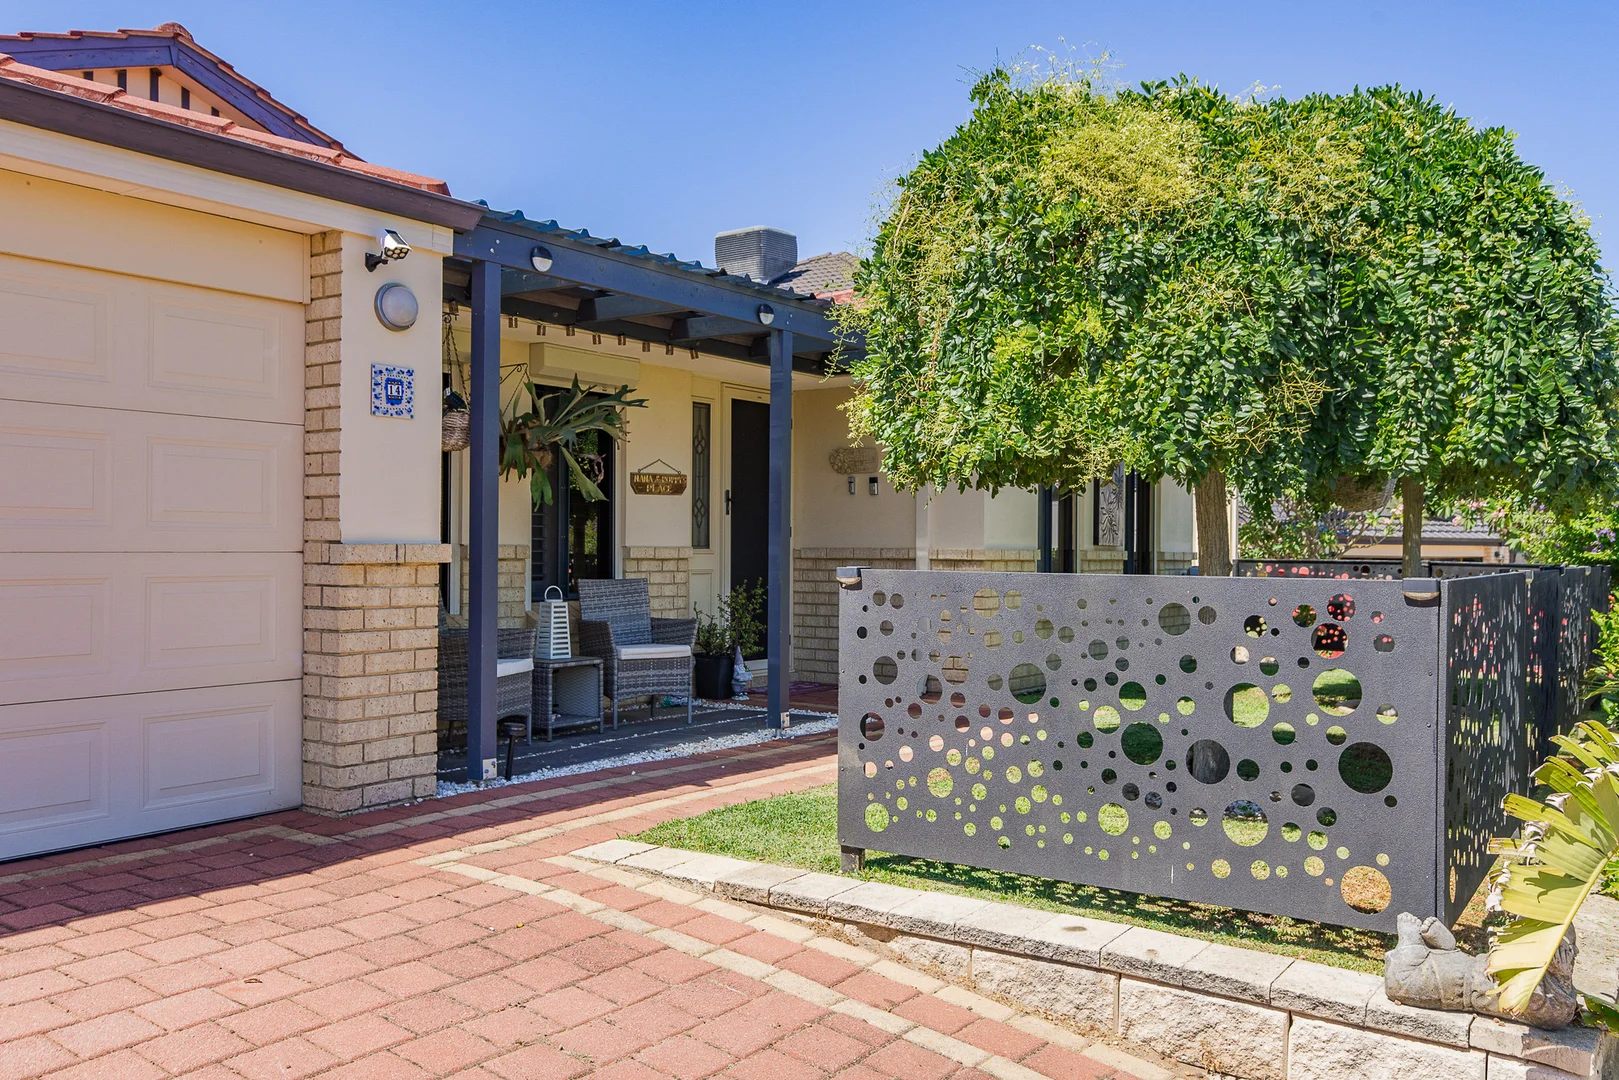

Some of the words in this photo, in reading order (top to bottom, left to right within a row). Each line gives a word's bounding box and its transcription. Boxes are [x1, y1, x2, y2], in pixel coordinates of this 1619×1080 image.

[389, 385, 400, 396] 14
[633, 474, 653, 483] NANA
[646, 484, 673, 493] PLACE
